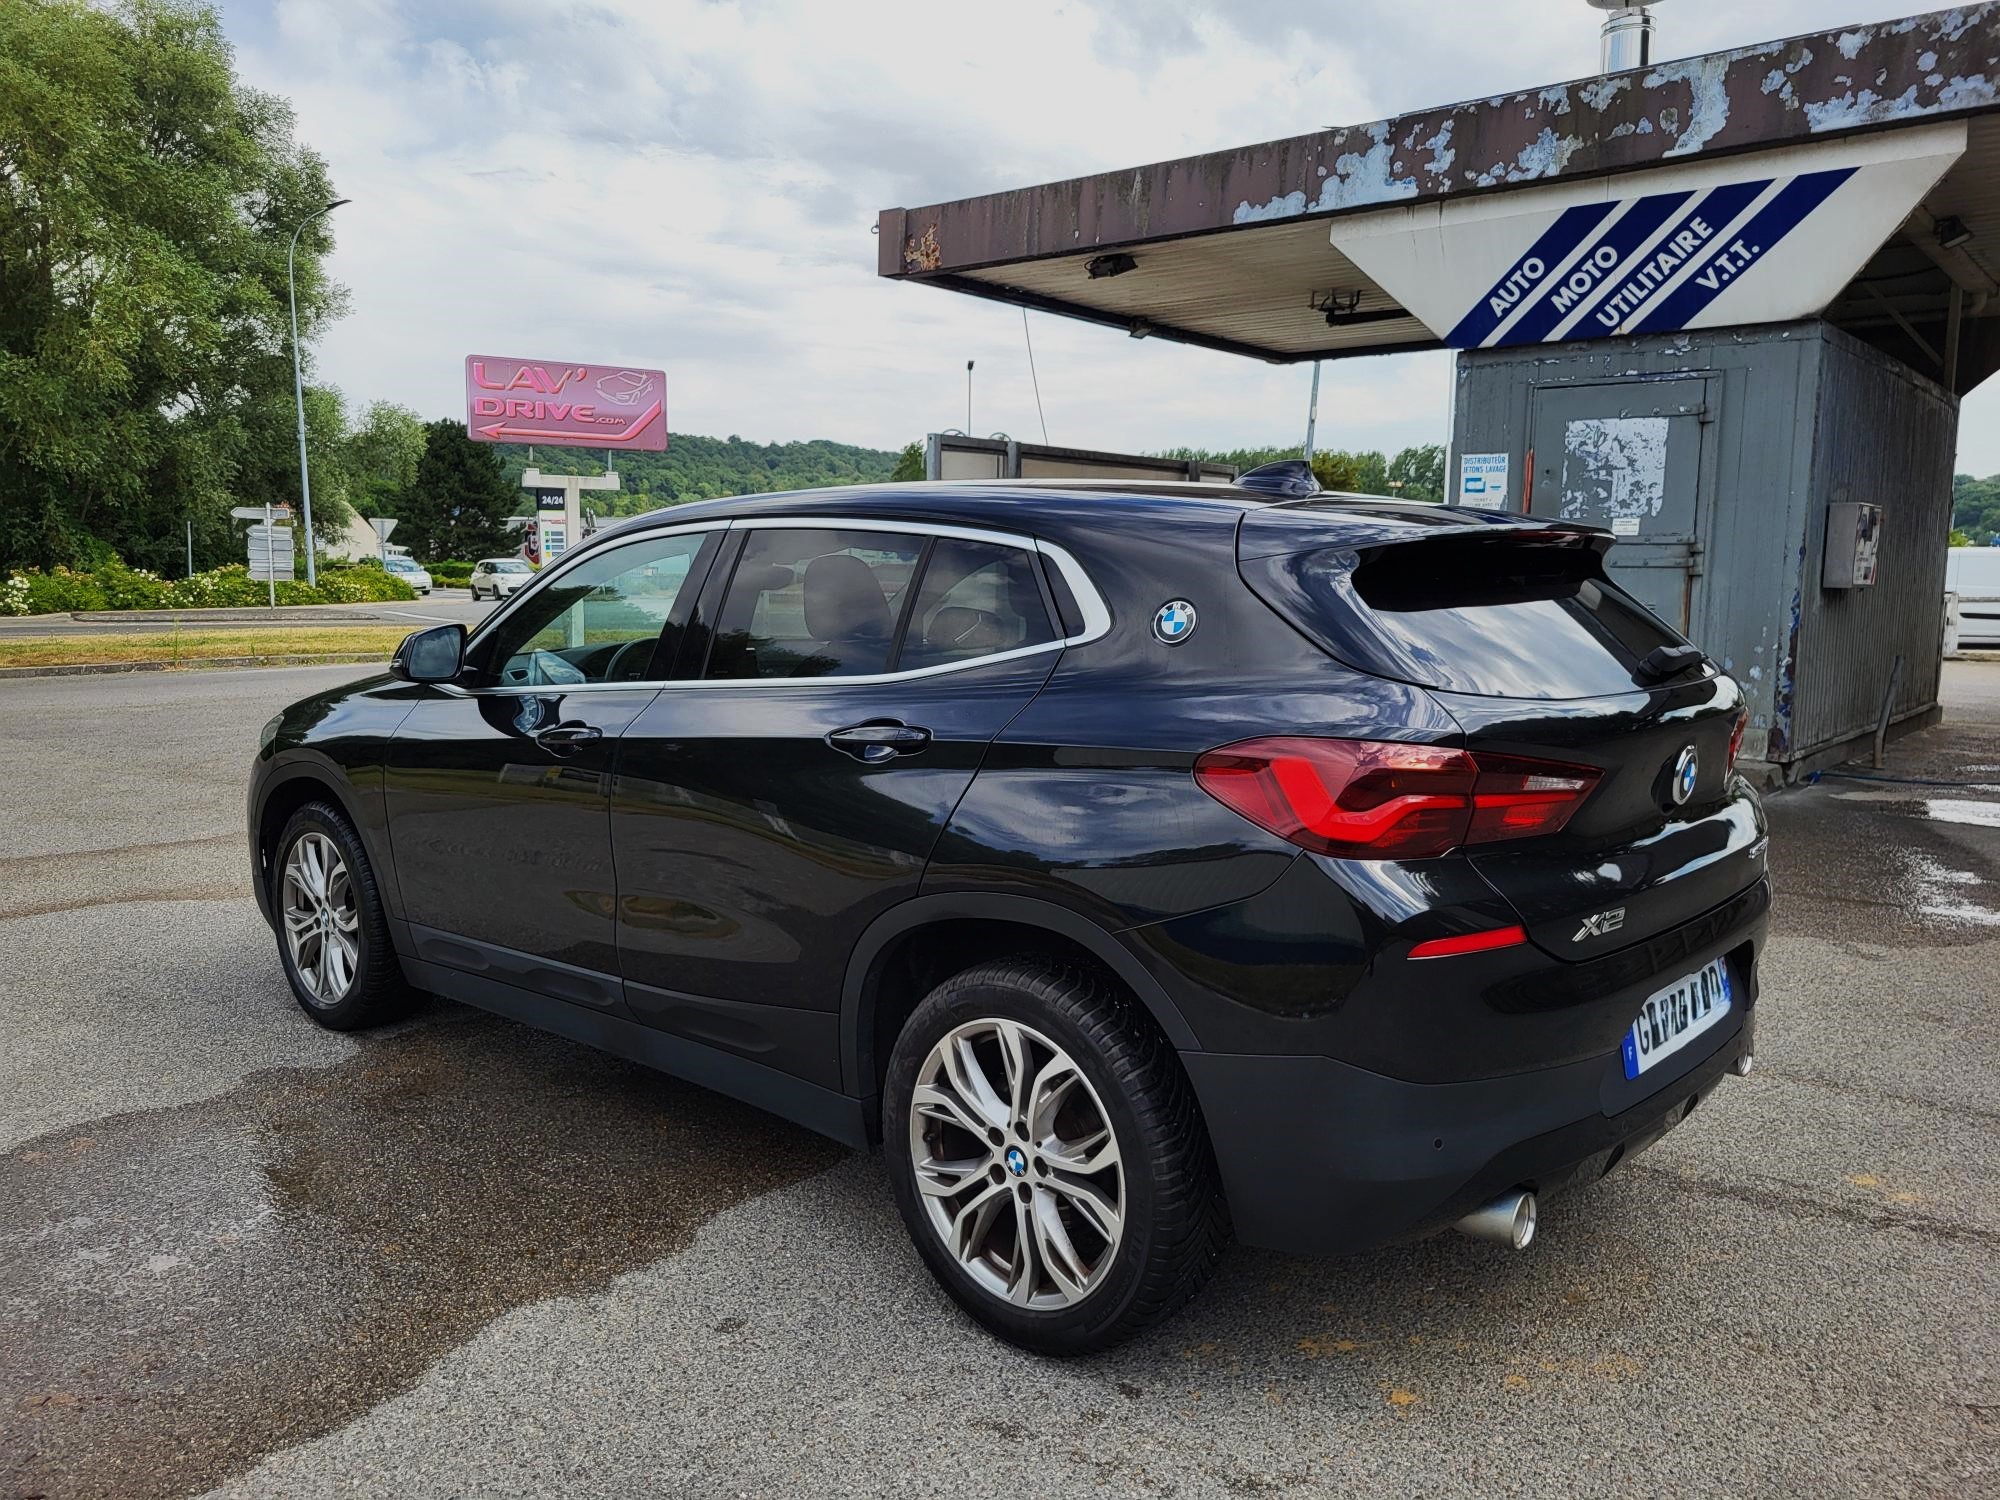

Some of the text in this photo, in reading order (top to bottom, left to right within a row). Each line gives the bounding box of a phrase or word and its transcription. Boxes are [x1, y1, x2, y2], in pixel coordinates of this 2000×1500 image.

[1550, 246, 1618, 314] MOTO
[1595, 216, 1714, 328] UTILITAIRE
[1695, 237, 1760, 292] V.T.T.
[1489, 257, 1545, 318] AUTO
[473, 362, 588, 394] LAV'
[1463, 456, 1506, 465] DISTRIBUTEUR
[1485, 465, 1506, 473] LAVAGE
[542, 495, 564, 505] 24/24
[1572, 906, 1626, 942] X2
